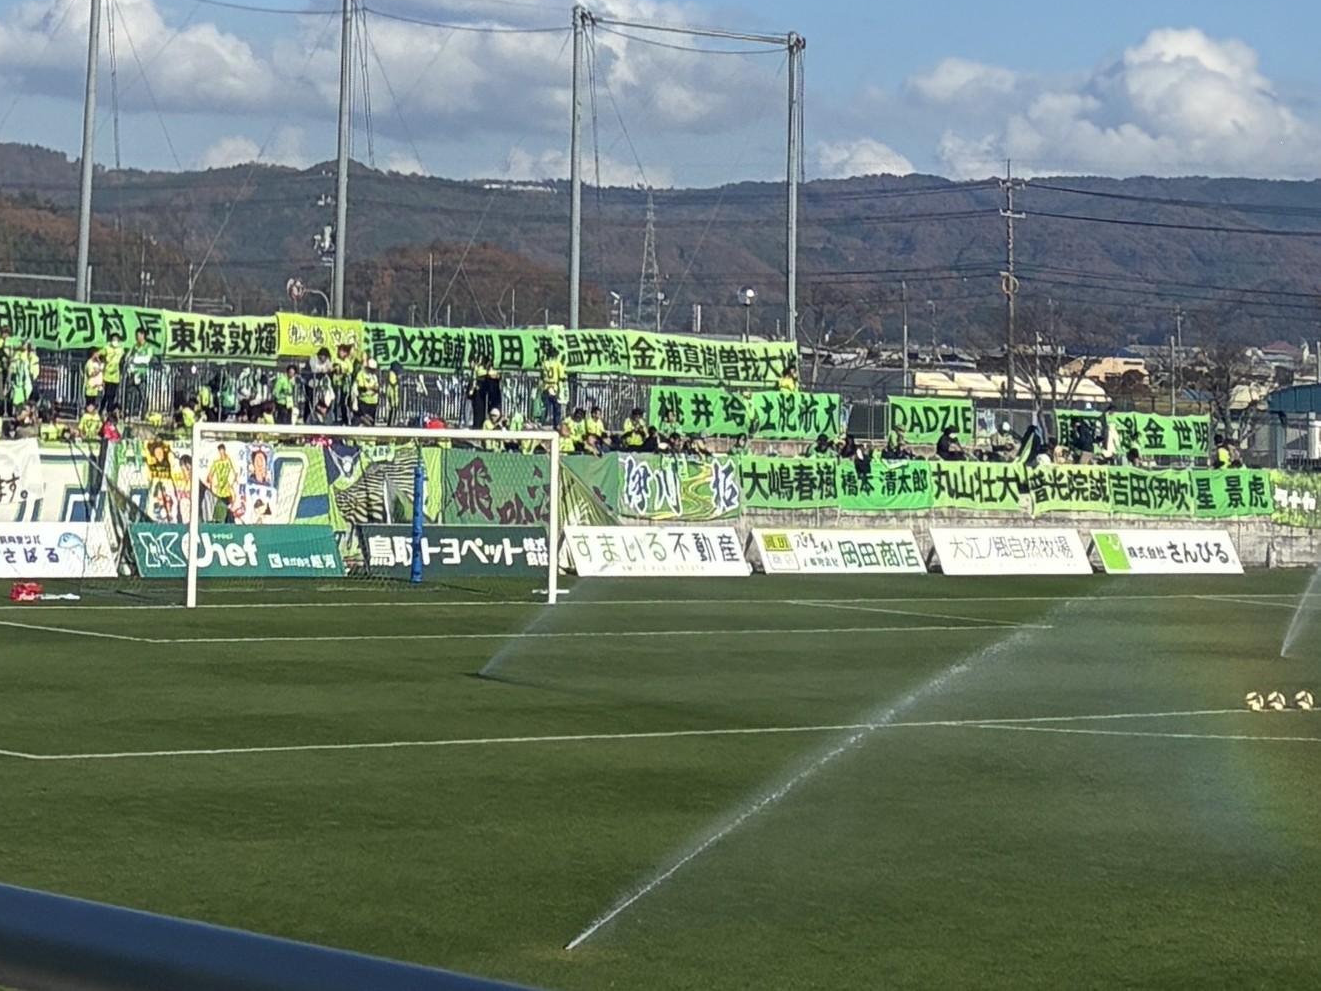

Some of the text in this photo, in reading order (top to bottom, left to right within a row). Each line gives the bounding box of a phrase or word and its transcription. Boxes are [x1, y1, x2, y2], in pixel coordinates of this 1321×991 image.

[890, 405, 972, 434] DADZIE
[572, 533, 741, 562] すまいる不動産
[838, 539, 920, 567] 岡田商店
